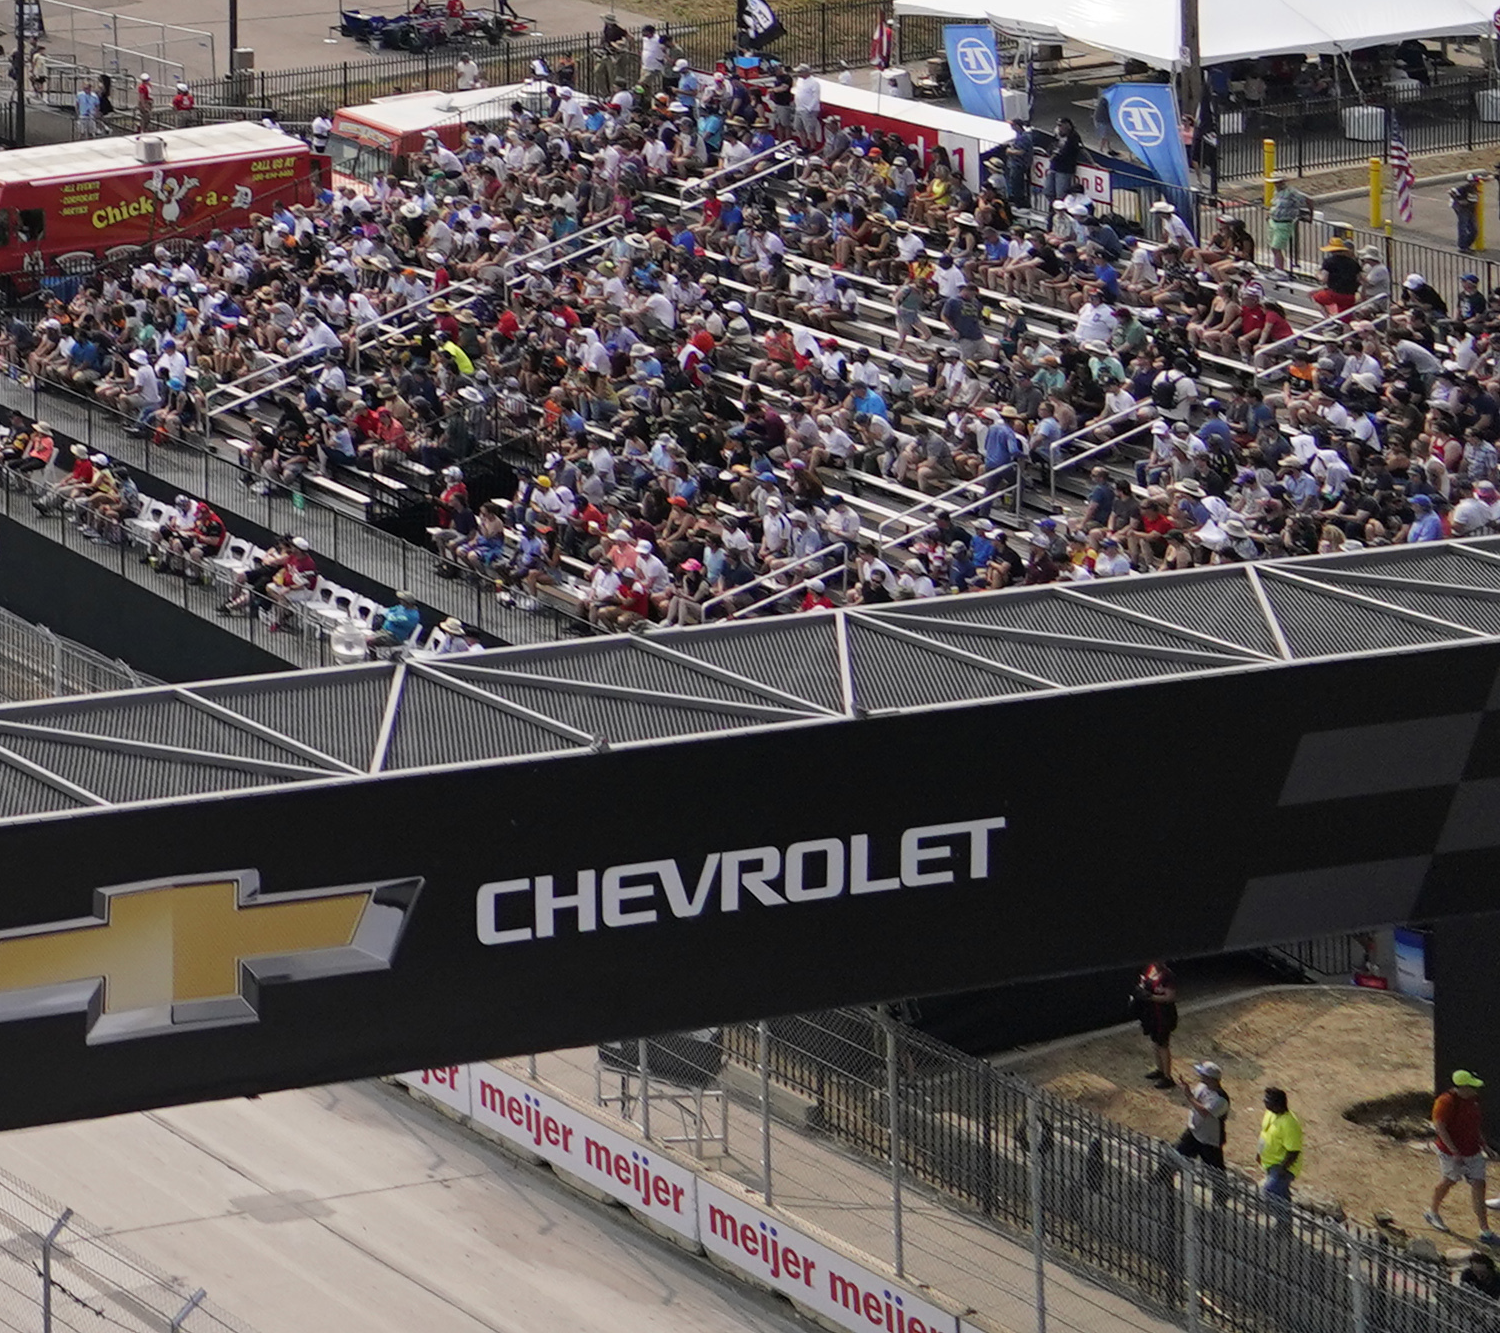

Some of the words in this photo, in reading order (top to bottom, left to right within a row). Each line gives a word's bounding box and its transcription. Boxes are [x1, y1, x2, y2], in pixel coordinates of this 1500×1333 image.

[251, 160, 270, 172] CALL
[92, 196, 155, 230] Chick
[476, 817, 1006, 945] CHEVROLET
[478, 1093, 574, 1155] meijer
[584, 1148, 685, 1215] meijer
[707, 1201, 817, 1288] meijer
